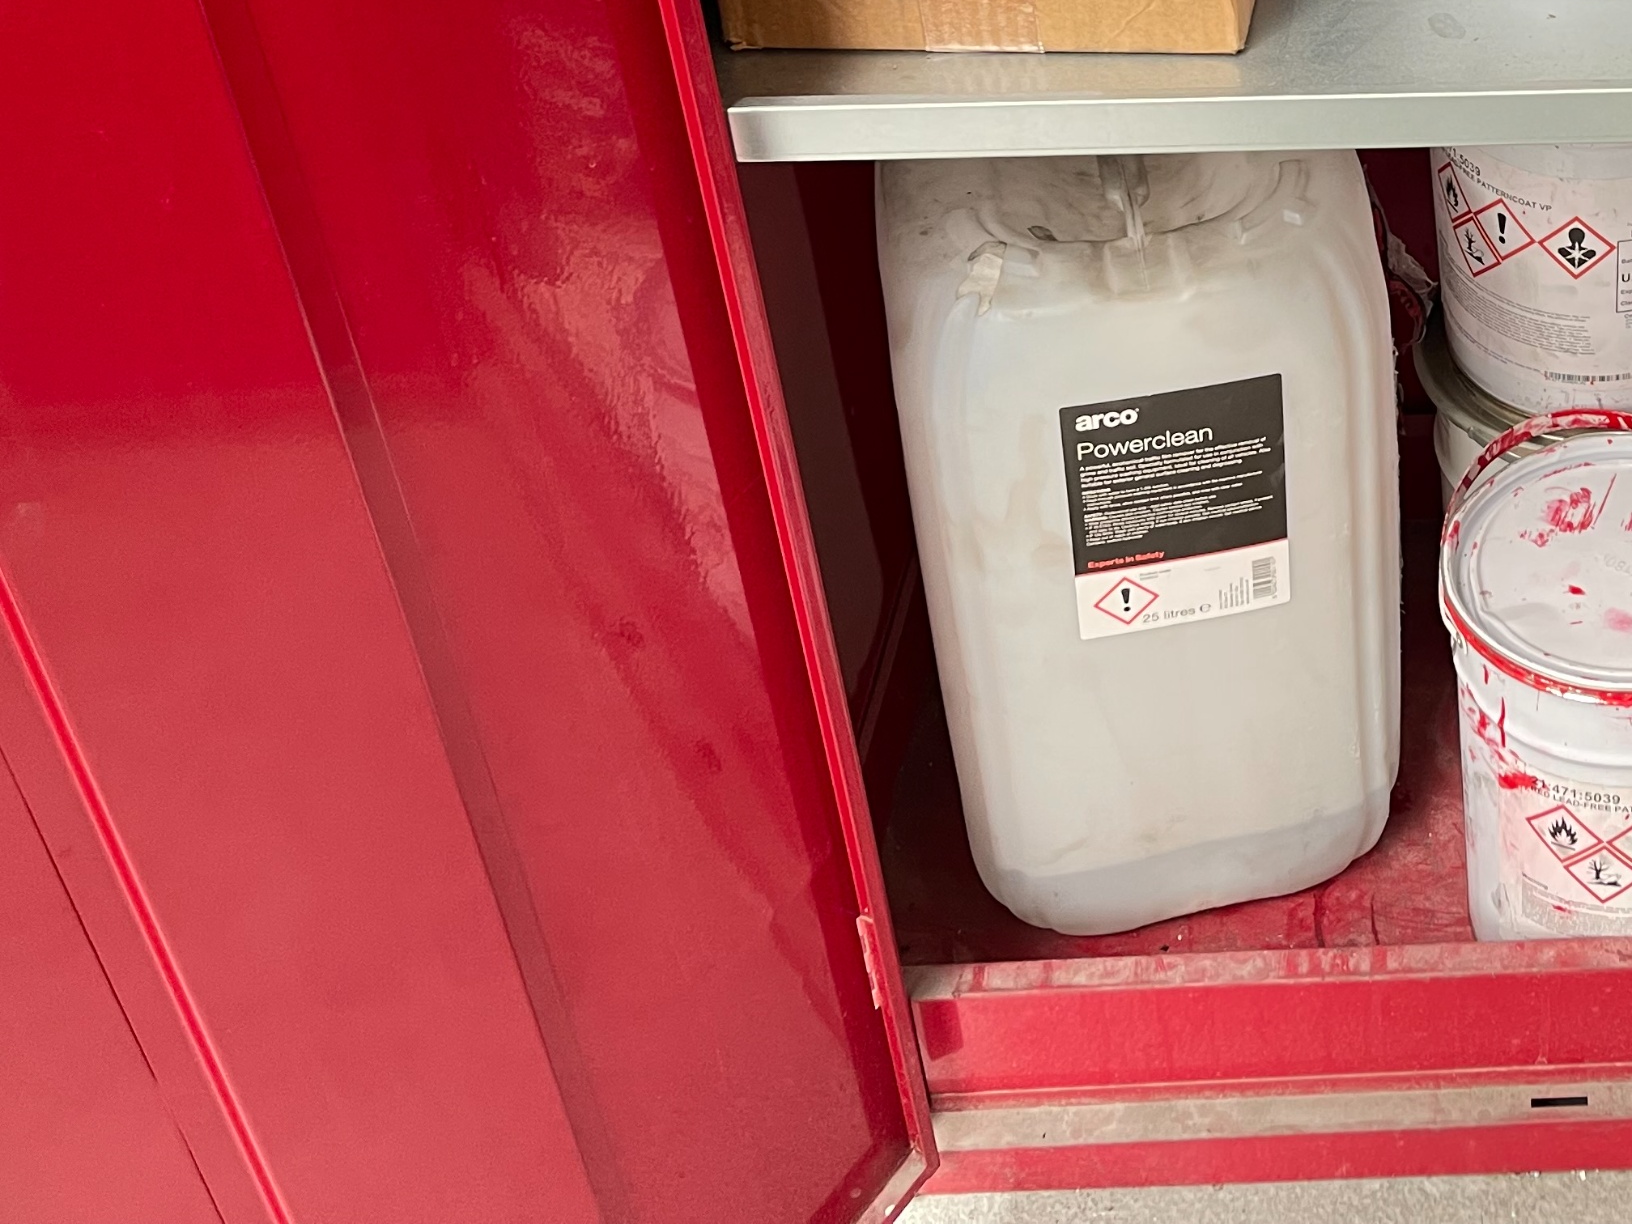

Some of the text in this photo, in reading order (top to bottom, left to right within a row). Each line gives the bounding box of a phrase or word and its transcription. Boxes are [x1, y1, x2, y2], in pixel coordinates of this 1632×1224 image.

[1476, 177, 1553, 212] PATTERNCOAT VP
[1075, 408, 1139, 432] arco
[1076, 426, 1214, 462] Powerclean
[1087, 549, 1166, 569] Experts in Safety
[1142, 607, 1197, 624] 25 litres
[1552, 793, 1612, 812] LEAD-FREE
